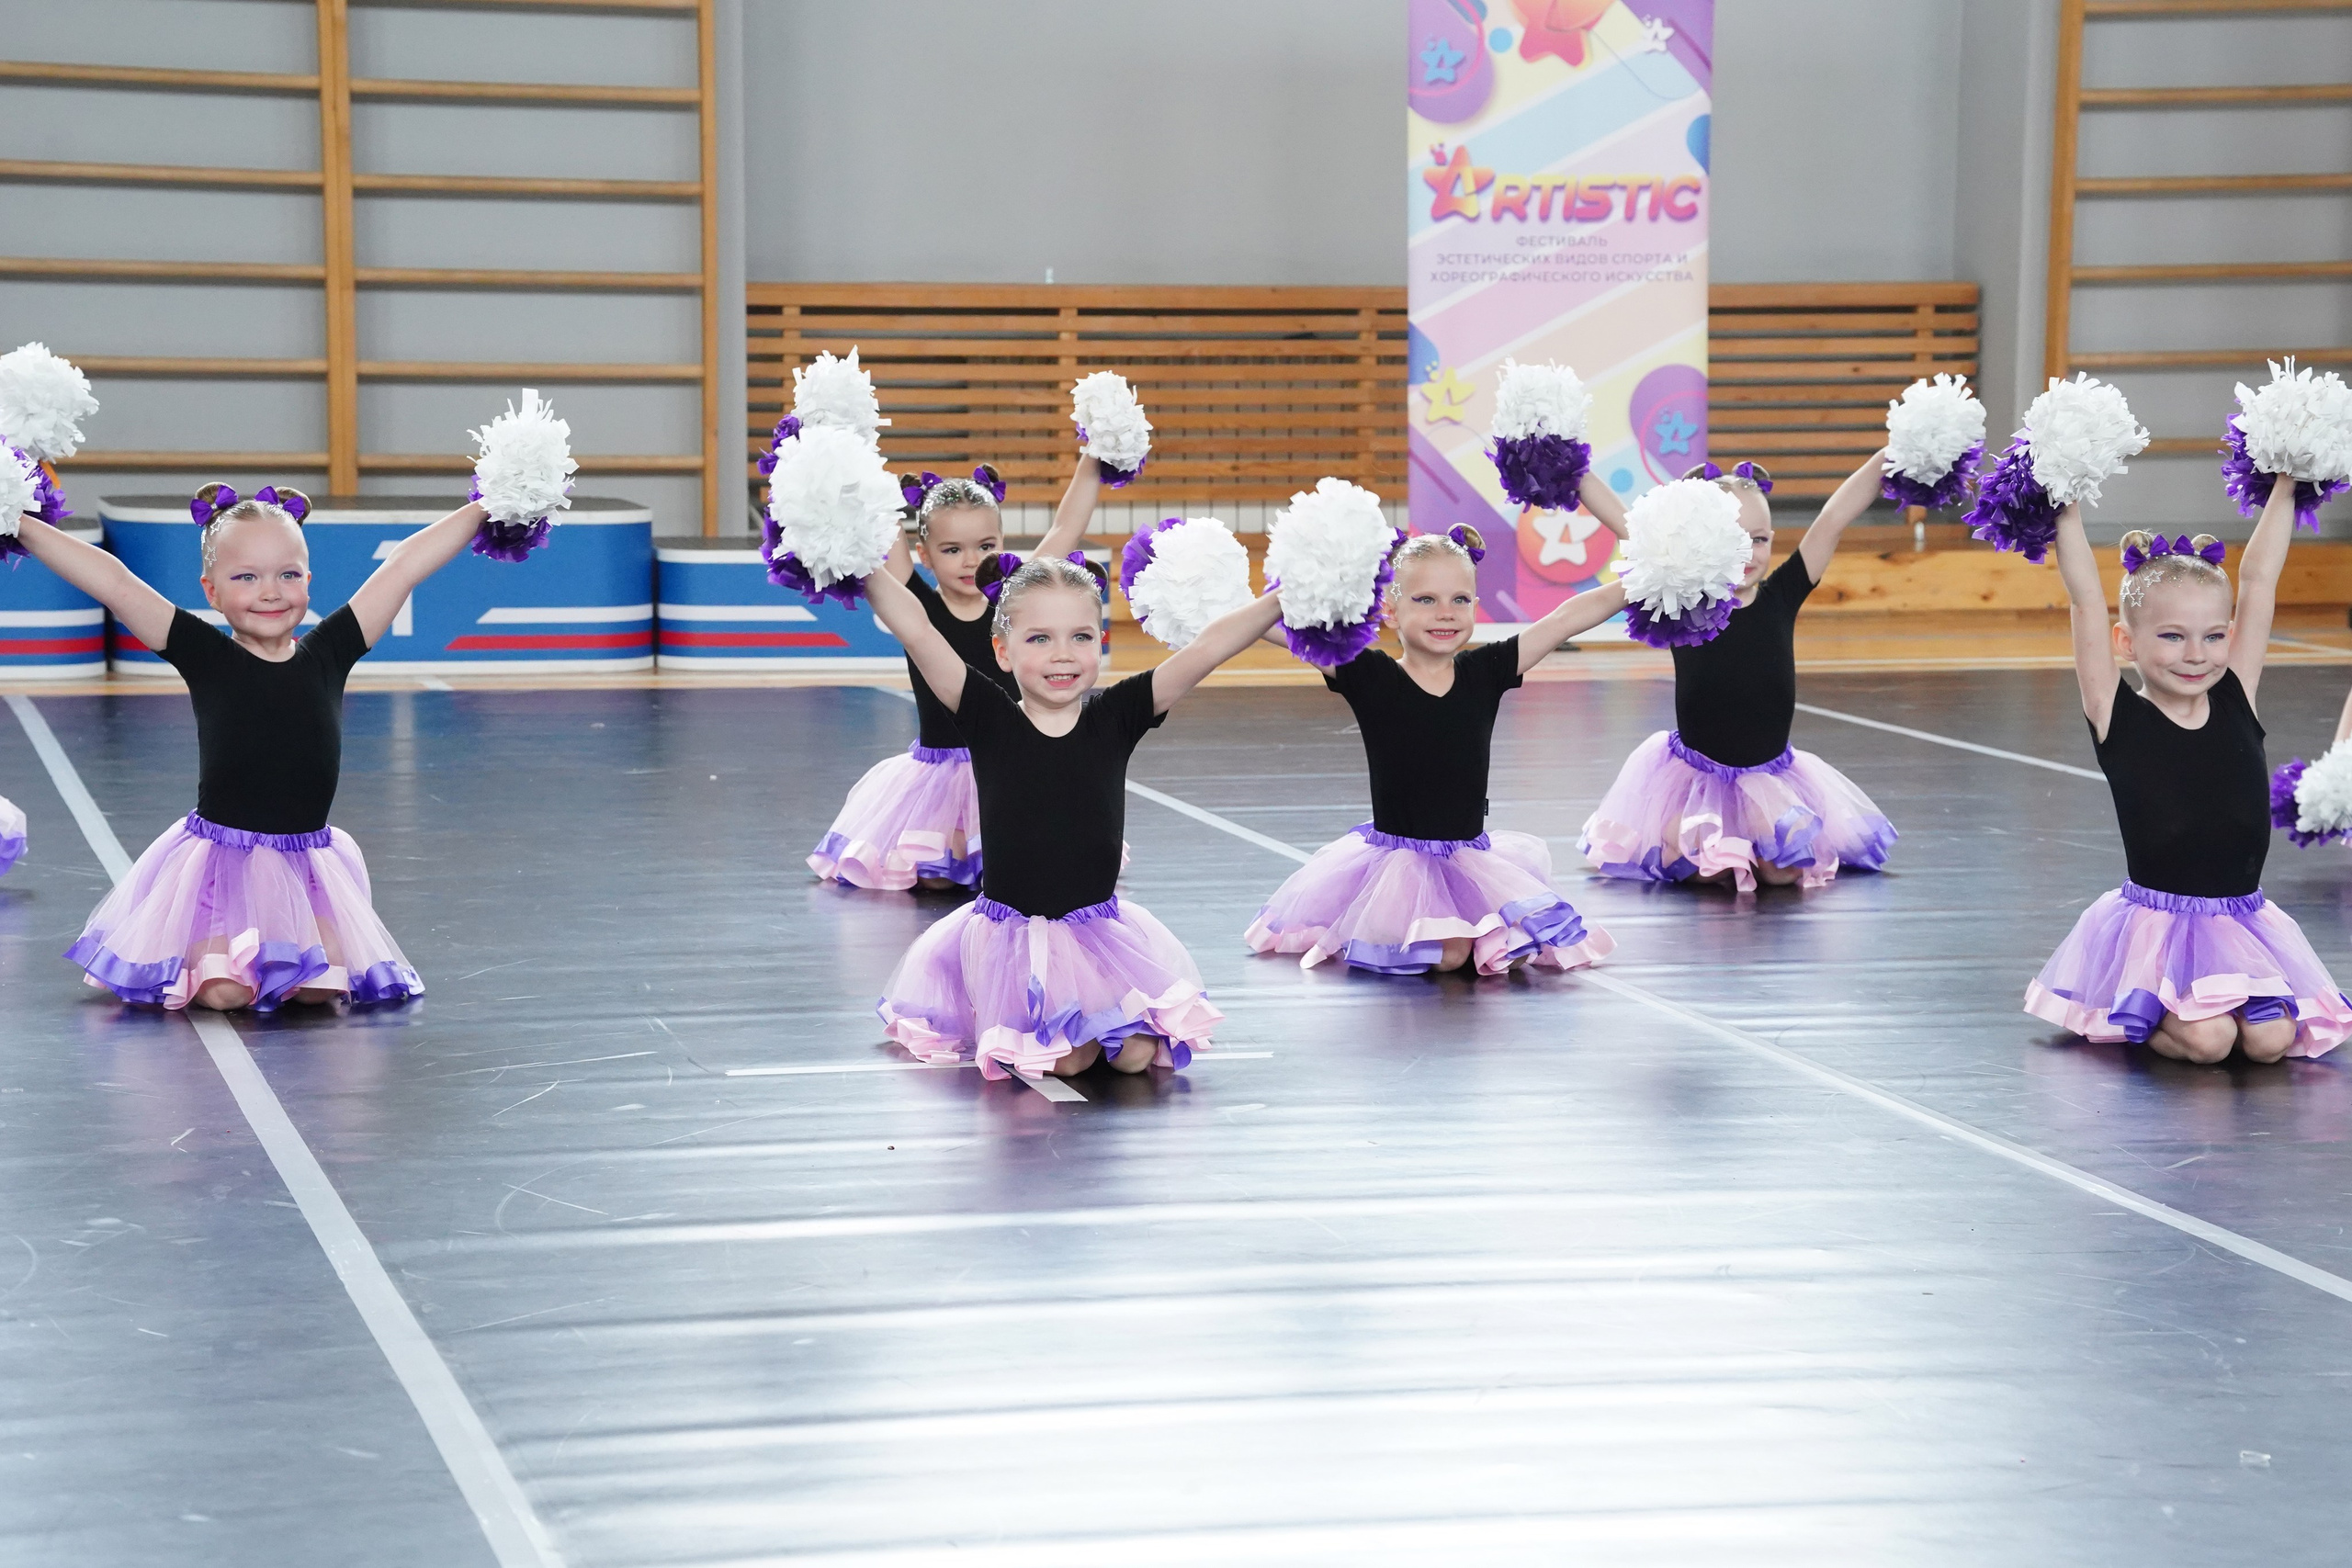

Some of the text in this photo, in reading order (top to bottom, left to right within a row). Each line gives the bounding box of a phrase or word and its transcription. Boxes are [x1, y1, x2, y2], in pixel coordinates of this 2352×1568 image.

[1423, 144, 1702, 222] ARTISTIC
[1516, 235, 1608, 247] ФЕСТИВАЛЬ
[1436, 253, 1688, 265] ЭСТЕТИЧЕСКИХ ВИДОВ СПОРТА И
[1430, 271, 1694, 283] ХОРЕОГРАФИЧЕСКОГО ИСКУССТВА
